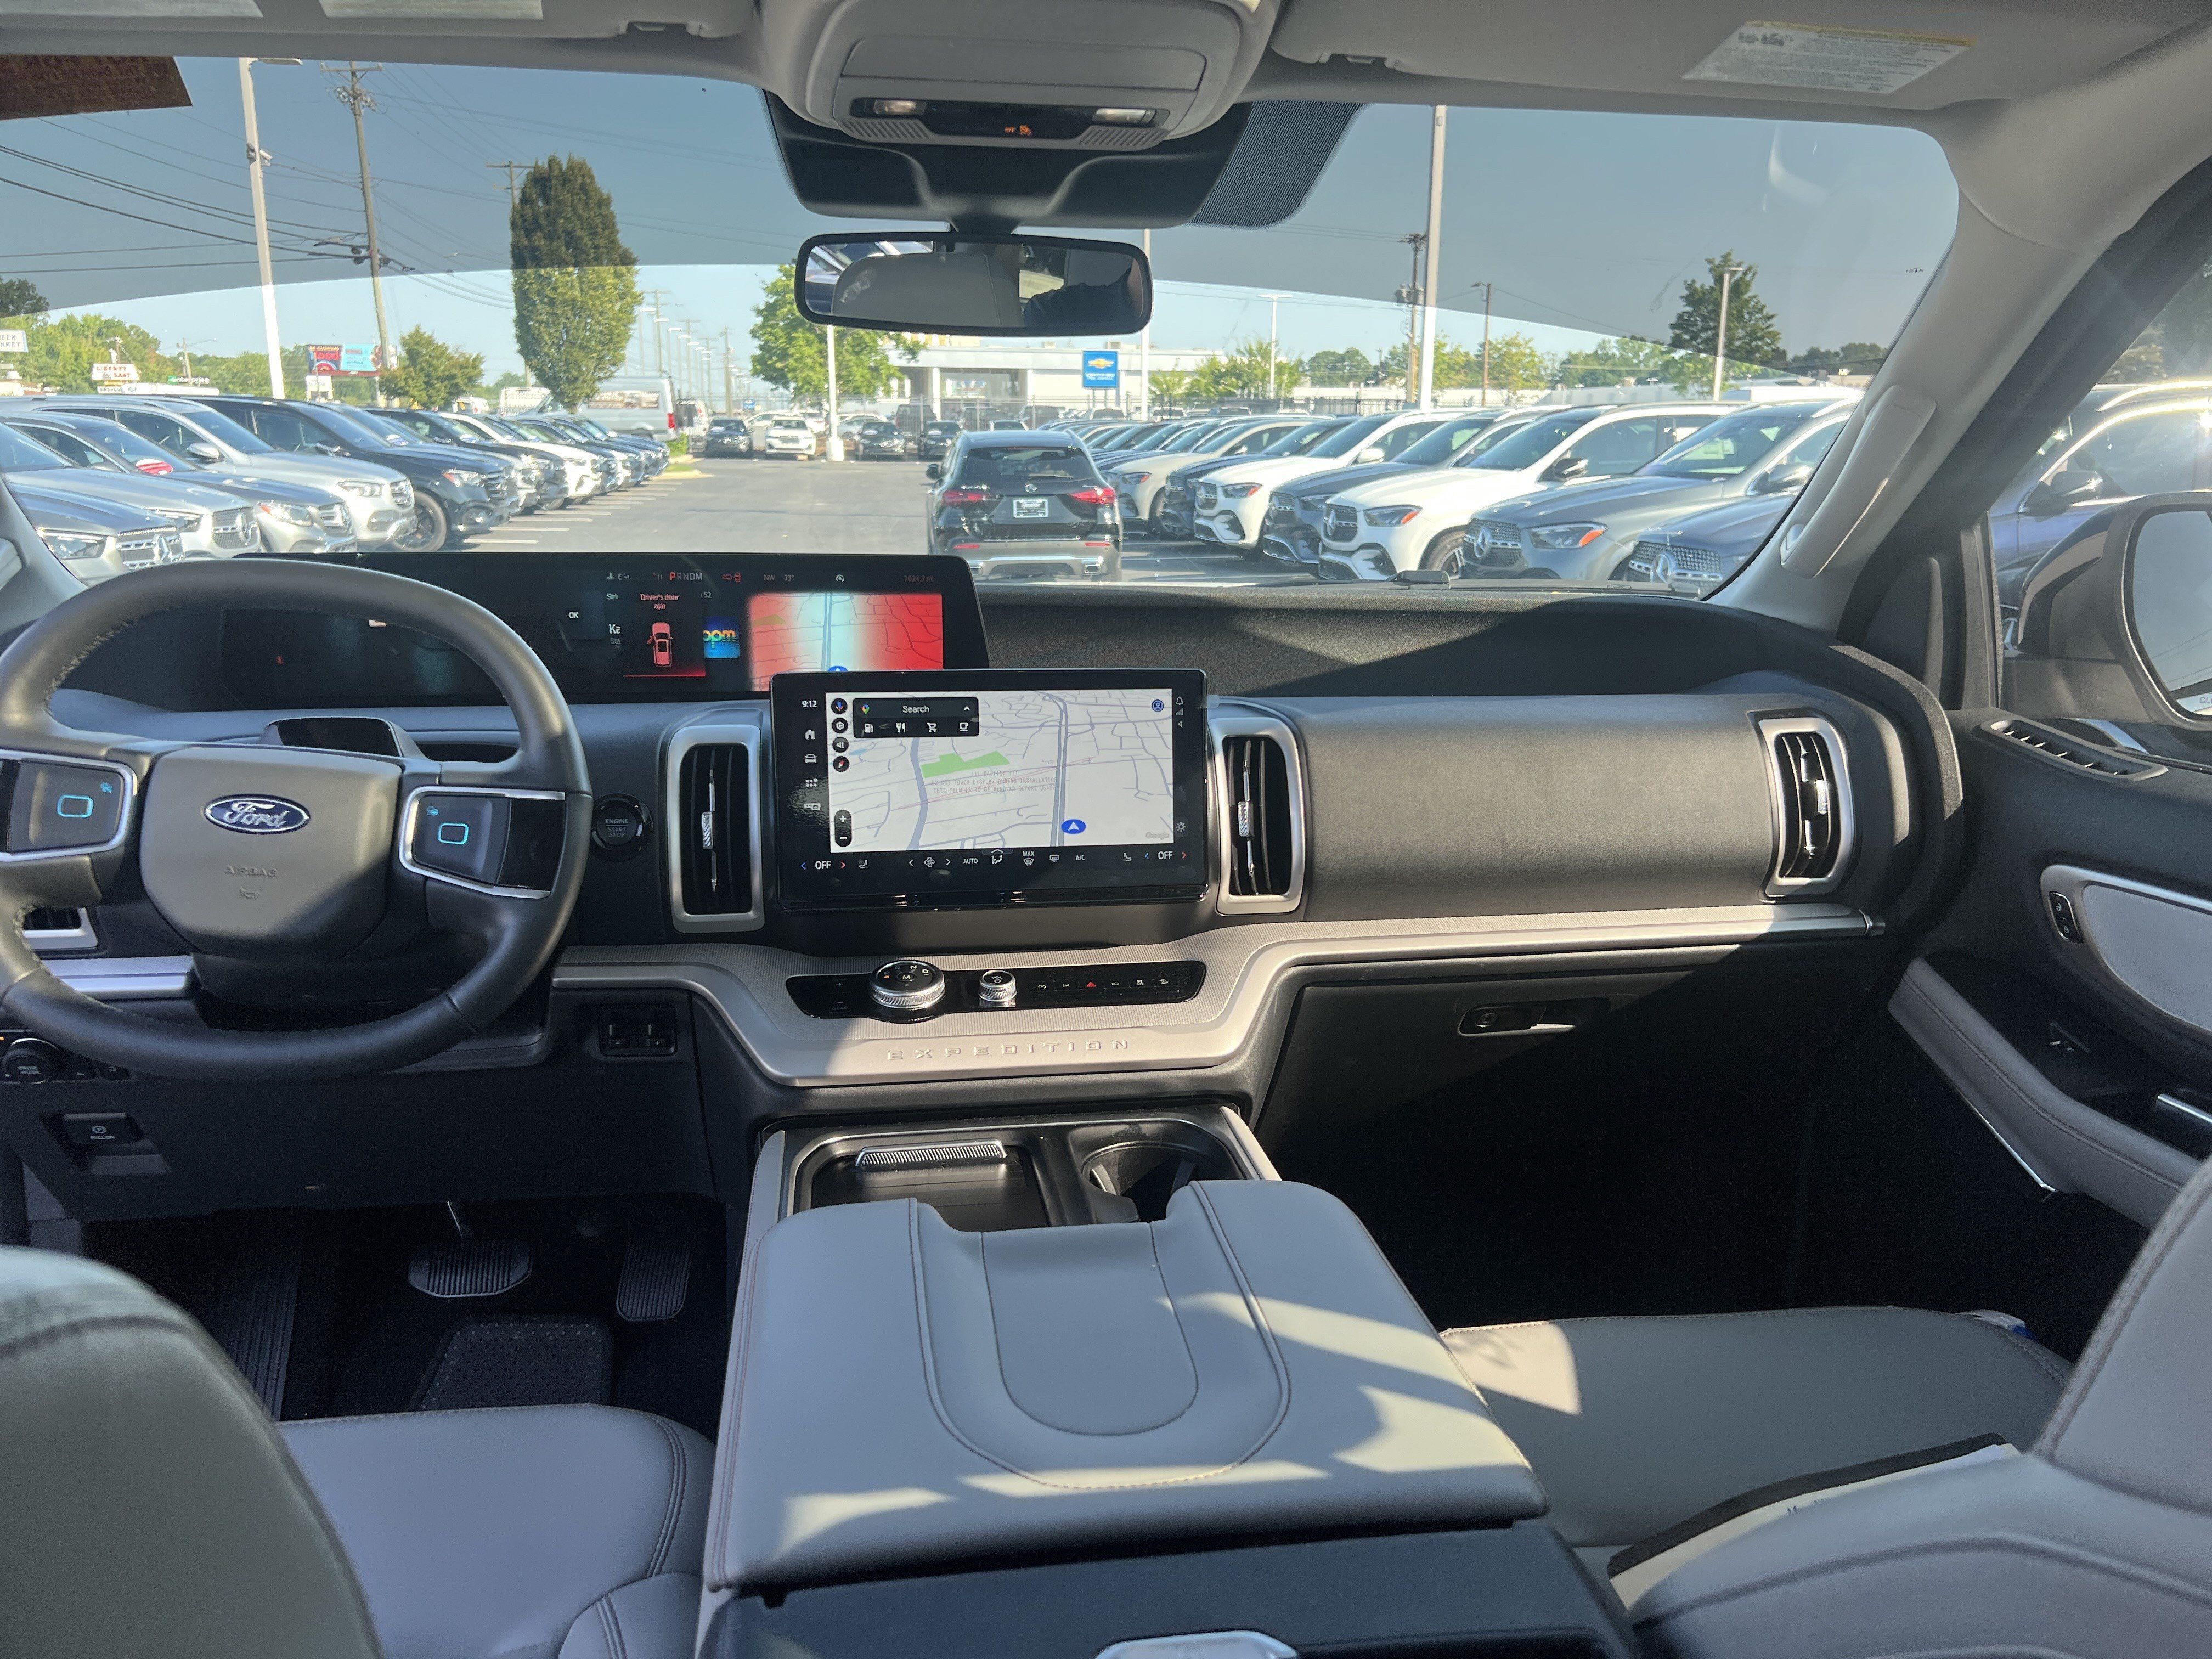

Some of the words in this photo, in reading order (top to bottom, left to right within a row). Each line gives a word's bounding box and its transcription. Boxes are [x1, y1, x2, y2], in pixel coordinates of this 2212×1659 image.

[802, 700, 817, 708] 9:12
[223, 801, 290, 827] Ford
[1146, 831, 1170, 840] Google
[1158, 851, 1173, 860] OFF
[815, 861, 832, 870] OFF
[887, 1039, 1128, 1060] EXPEDITION
